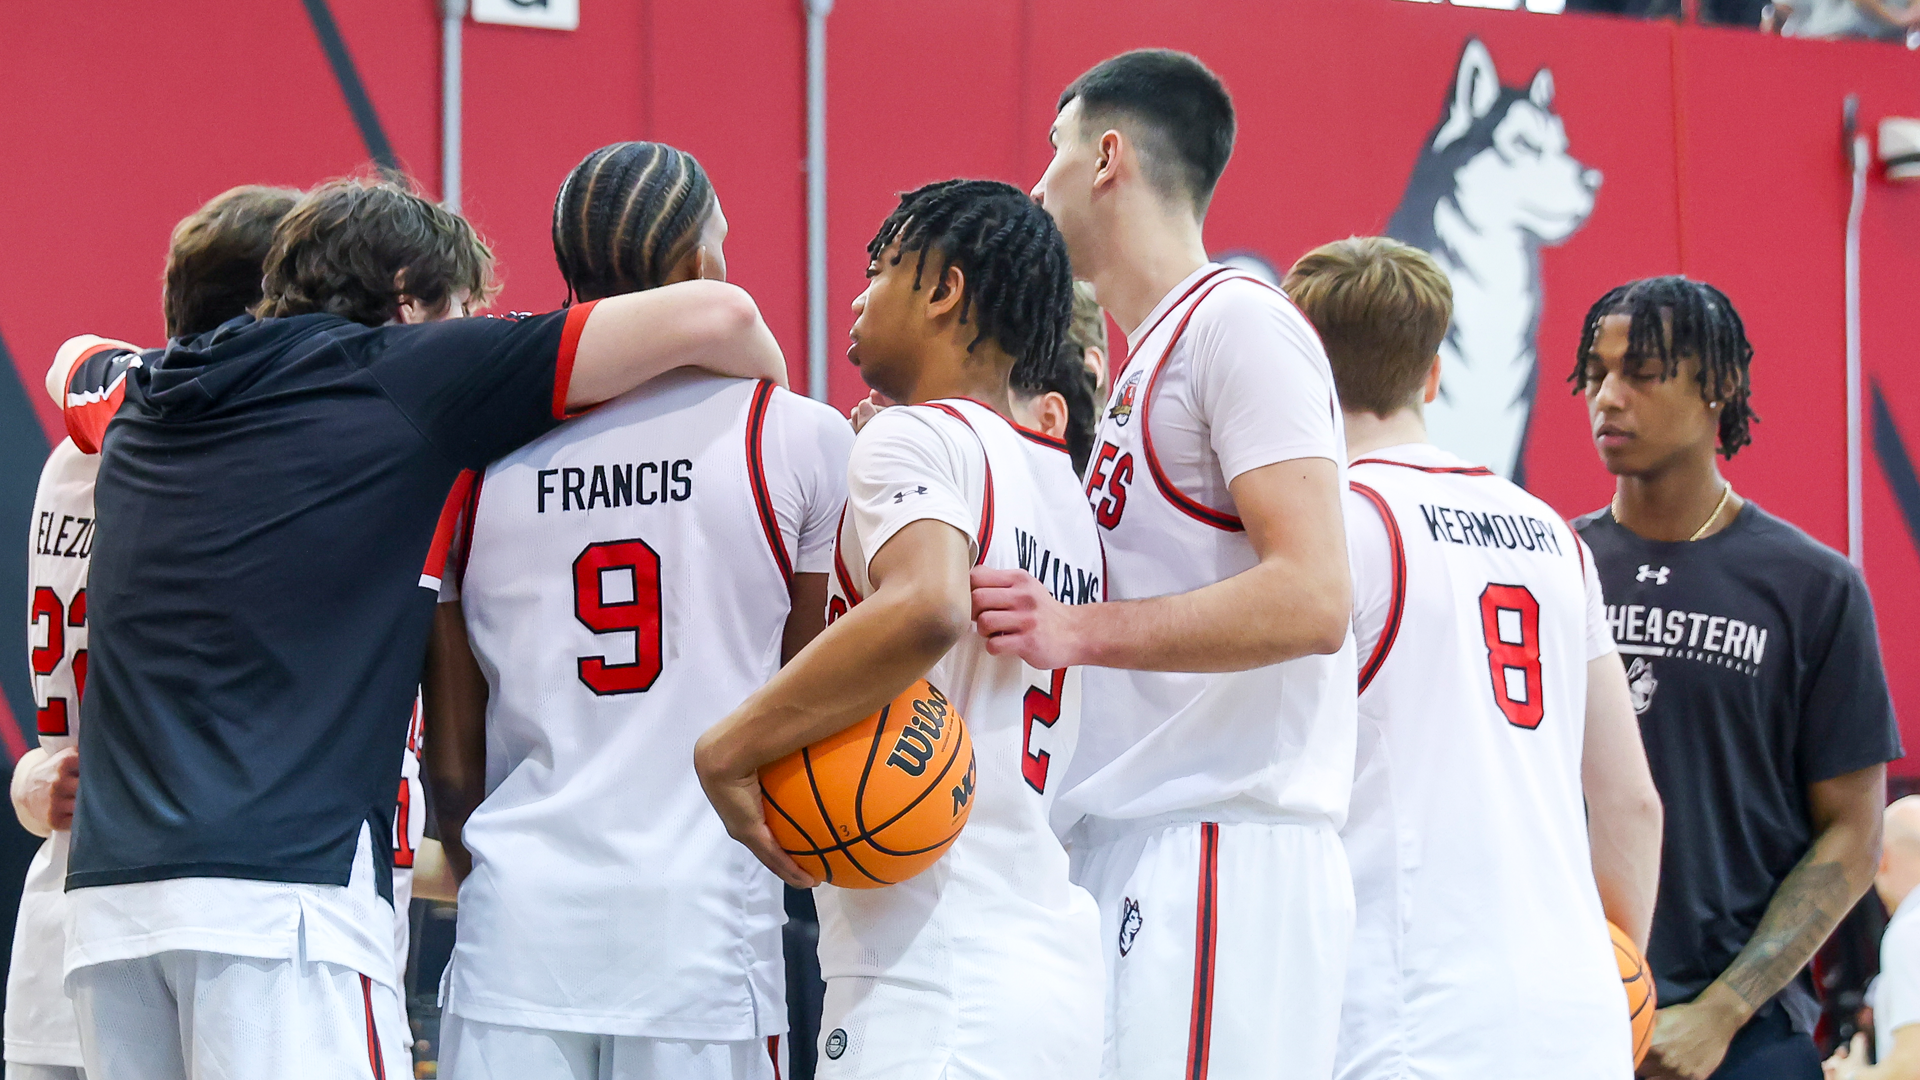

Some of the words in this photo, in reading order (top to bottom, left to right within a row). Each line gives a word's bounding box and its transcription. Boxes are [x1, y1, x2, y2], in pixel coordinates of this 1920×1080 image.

[537, 459, 693, 514] FRANCIS
[1419, 503, 1563, 558] KERMOURY
[572, 538, 663, 696] 9
[1478, 582, 1545, 730] 8
[1607, 604, 1768, 665] HEASTERN
[884, 680, 949, 777] Wilso
[1021, 667, 1068, 796] 2
